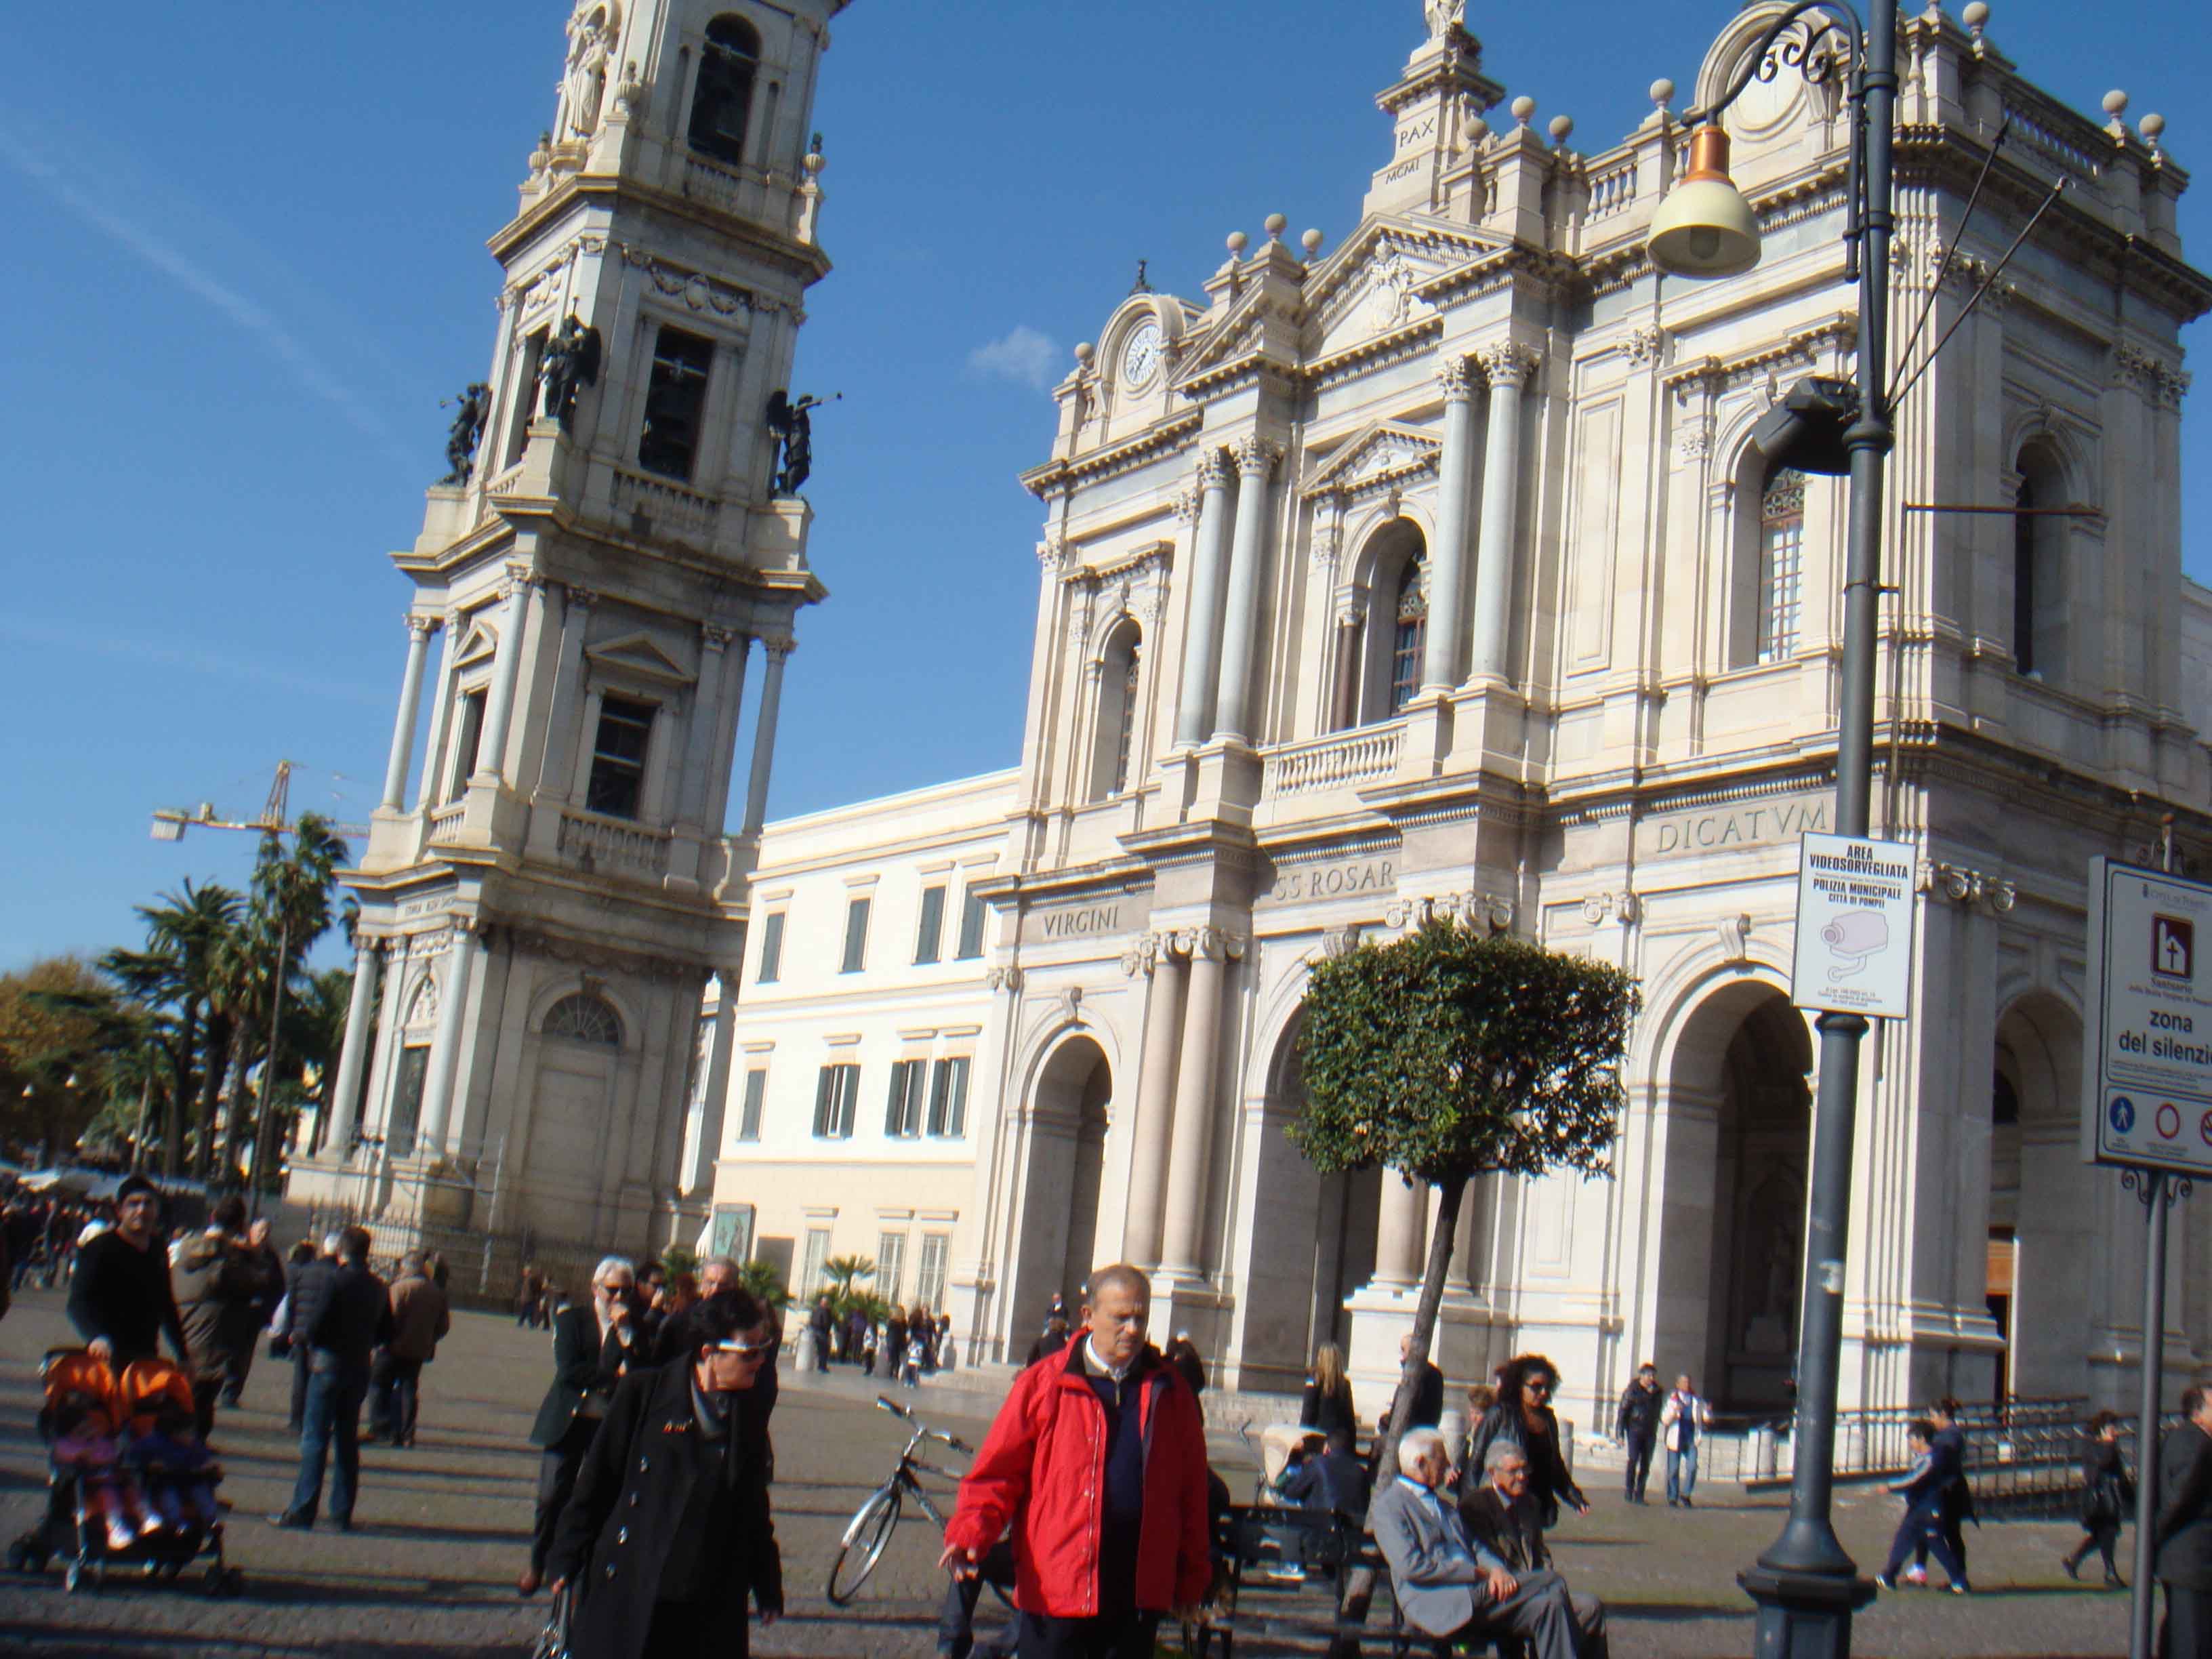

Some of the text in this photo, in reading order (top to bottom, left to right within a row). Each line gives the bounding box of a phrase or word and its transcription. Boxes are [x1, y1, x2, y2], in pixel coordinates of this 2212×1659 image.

[1399, 117, 1434, 147] PAX
[1386, 158, 1419, 184] MCMI
[1656, 800, 1826, 854] DICATVM
[1847, 844, 1873, 861] AREA
[1309, 861, 1394, 897] ROSAR
[1809, 853, 1908, 880] VIDEOSORVEGLIATA
[1813, 878, 1846, 893] POLIZIA
[1849, 882, 1902, 900] MUNICIPALE
[1849, 897, 1858, 905] DI
[1044, 905, 1118, 937] VIRGINI
[2150, 1009, 2192, 1033] zona
[2118, 1030, 2147, 1055] del
